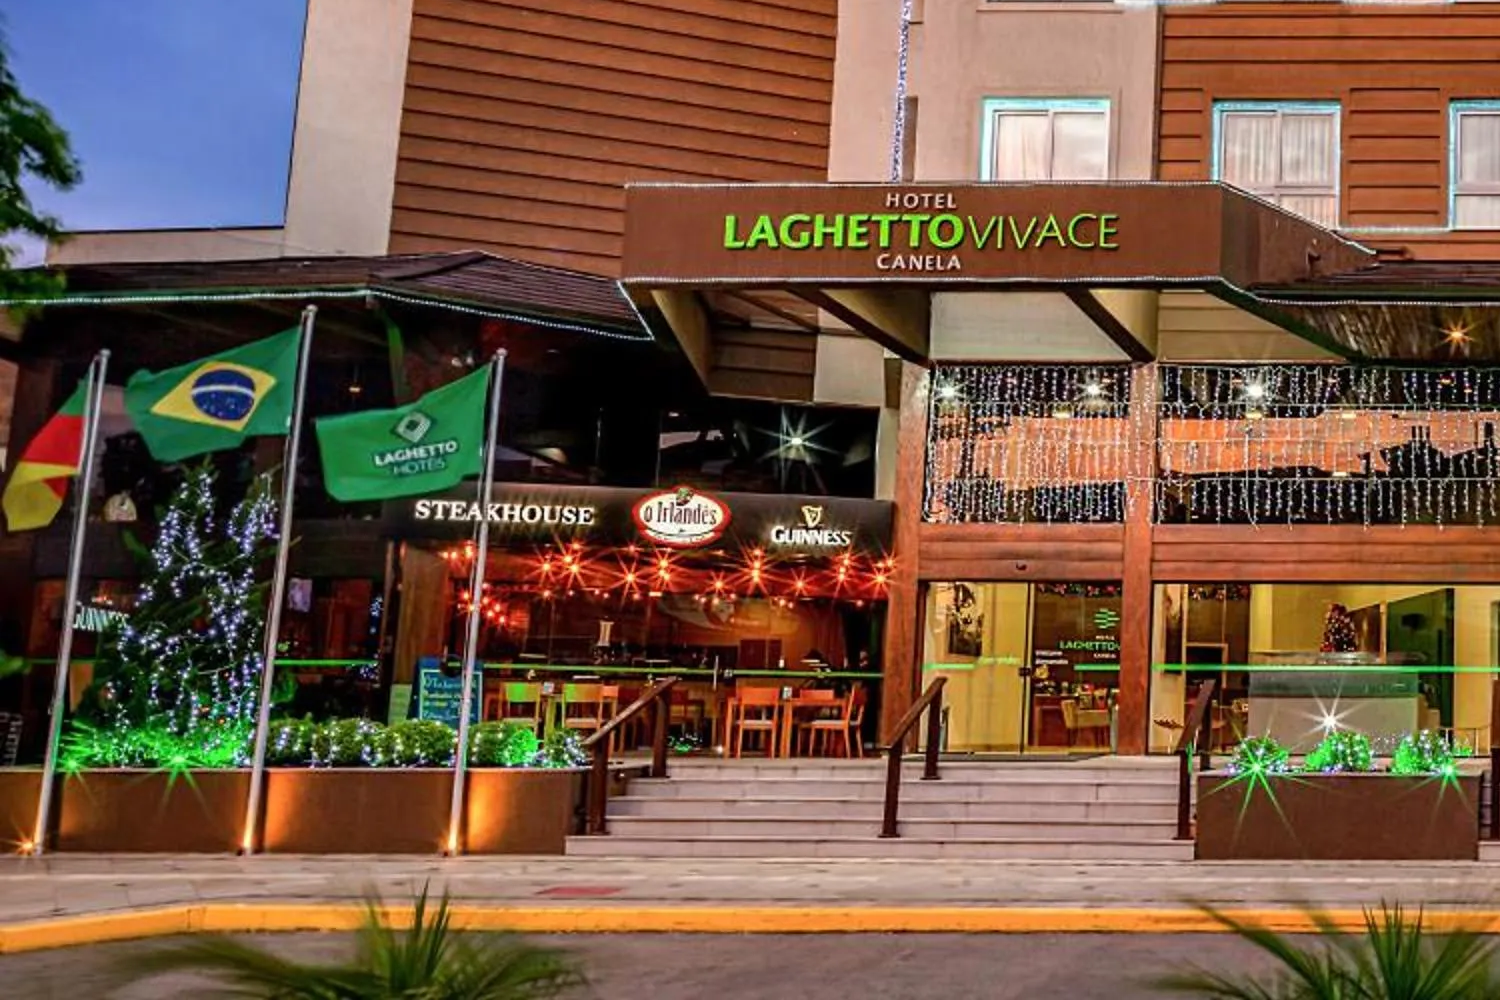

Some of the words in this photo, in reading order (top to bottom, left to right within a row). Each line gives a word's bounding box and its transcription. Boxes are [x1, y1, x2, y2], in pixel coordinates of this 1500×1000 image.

[886, 192, 957, 209] HOTEL
[723, 213, 964, 250] LAGHETTO
[967, 213, 1119, 250] VIVACE
[876, 253, 962, 271] CANELA
[374, 440, 457, 467] LAGHETTO
[415, 500, 595, 525] STEAKHOUSE
[771, 525, 852, 546] GUINNESS
